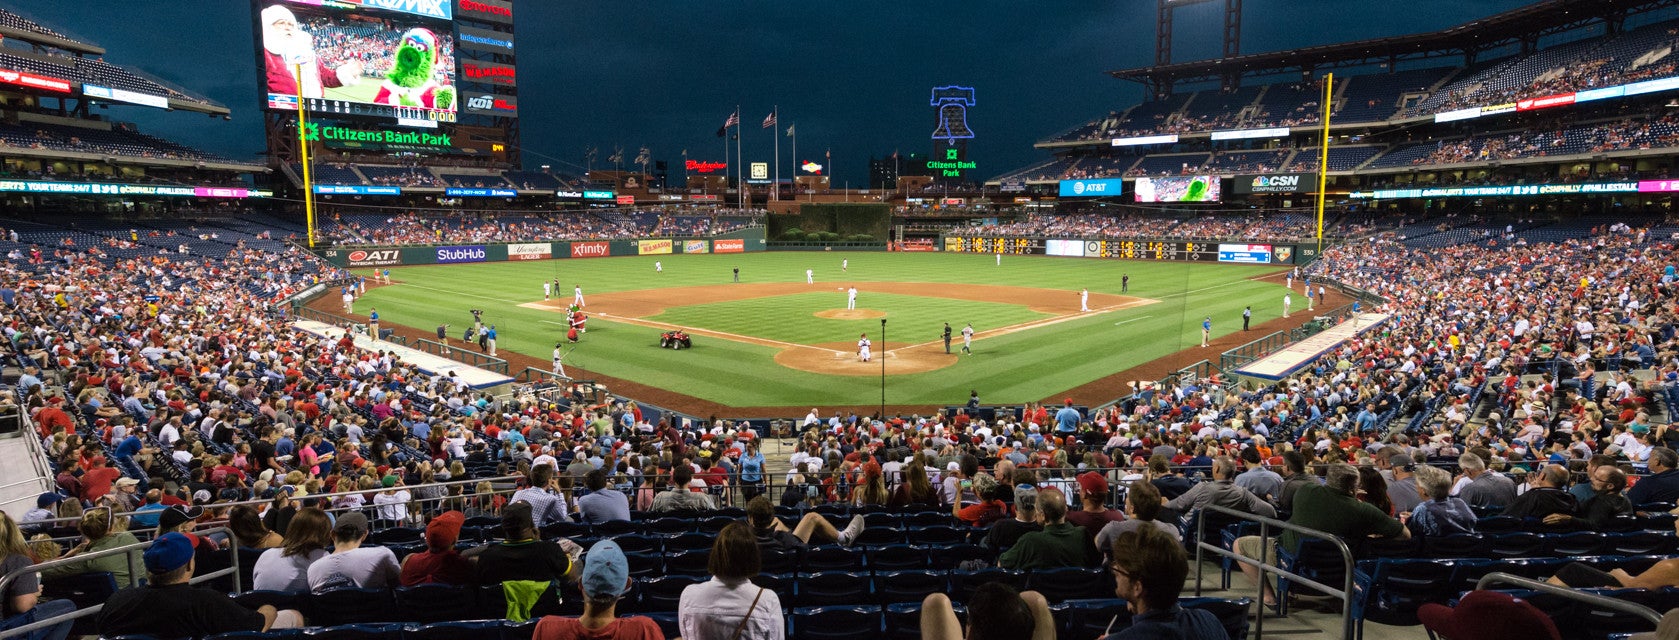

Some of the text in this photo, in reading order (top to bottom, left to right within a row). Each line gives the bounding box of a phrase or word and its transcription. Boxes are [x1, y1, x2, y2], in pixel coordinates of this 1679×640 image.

[472, 2, 512, 16] TOYOTA
[323, 126, 451, 146] Citizens Bank Park
[685, 160, 727, 170] Budweiser
[1270, 176, 1299, 186] CSN
[1086, 183, 1107, 191] AT&T
[574, 243, 607, 256] xfinity
[687, 242, 703, 250] Gulf
[366, 250, 399, 260] ATI
[438, 249, 485, 260] StubHub
